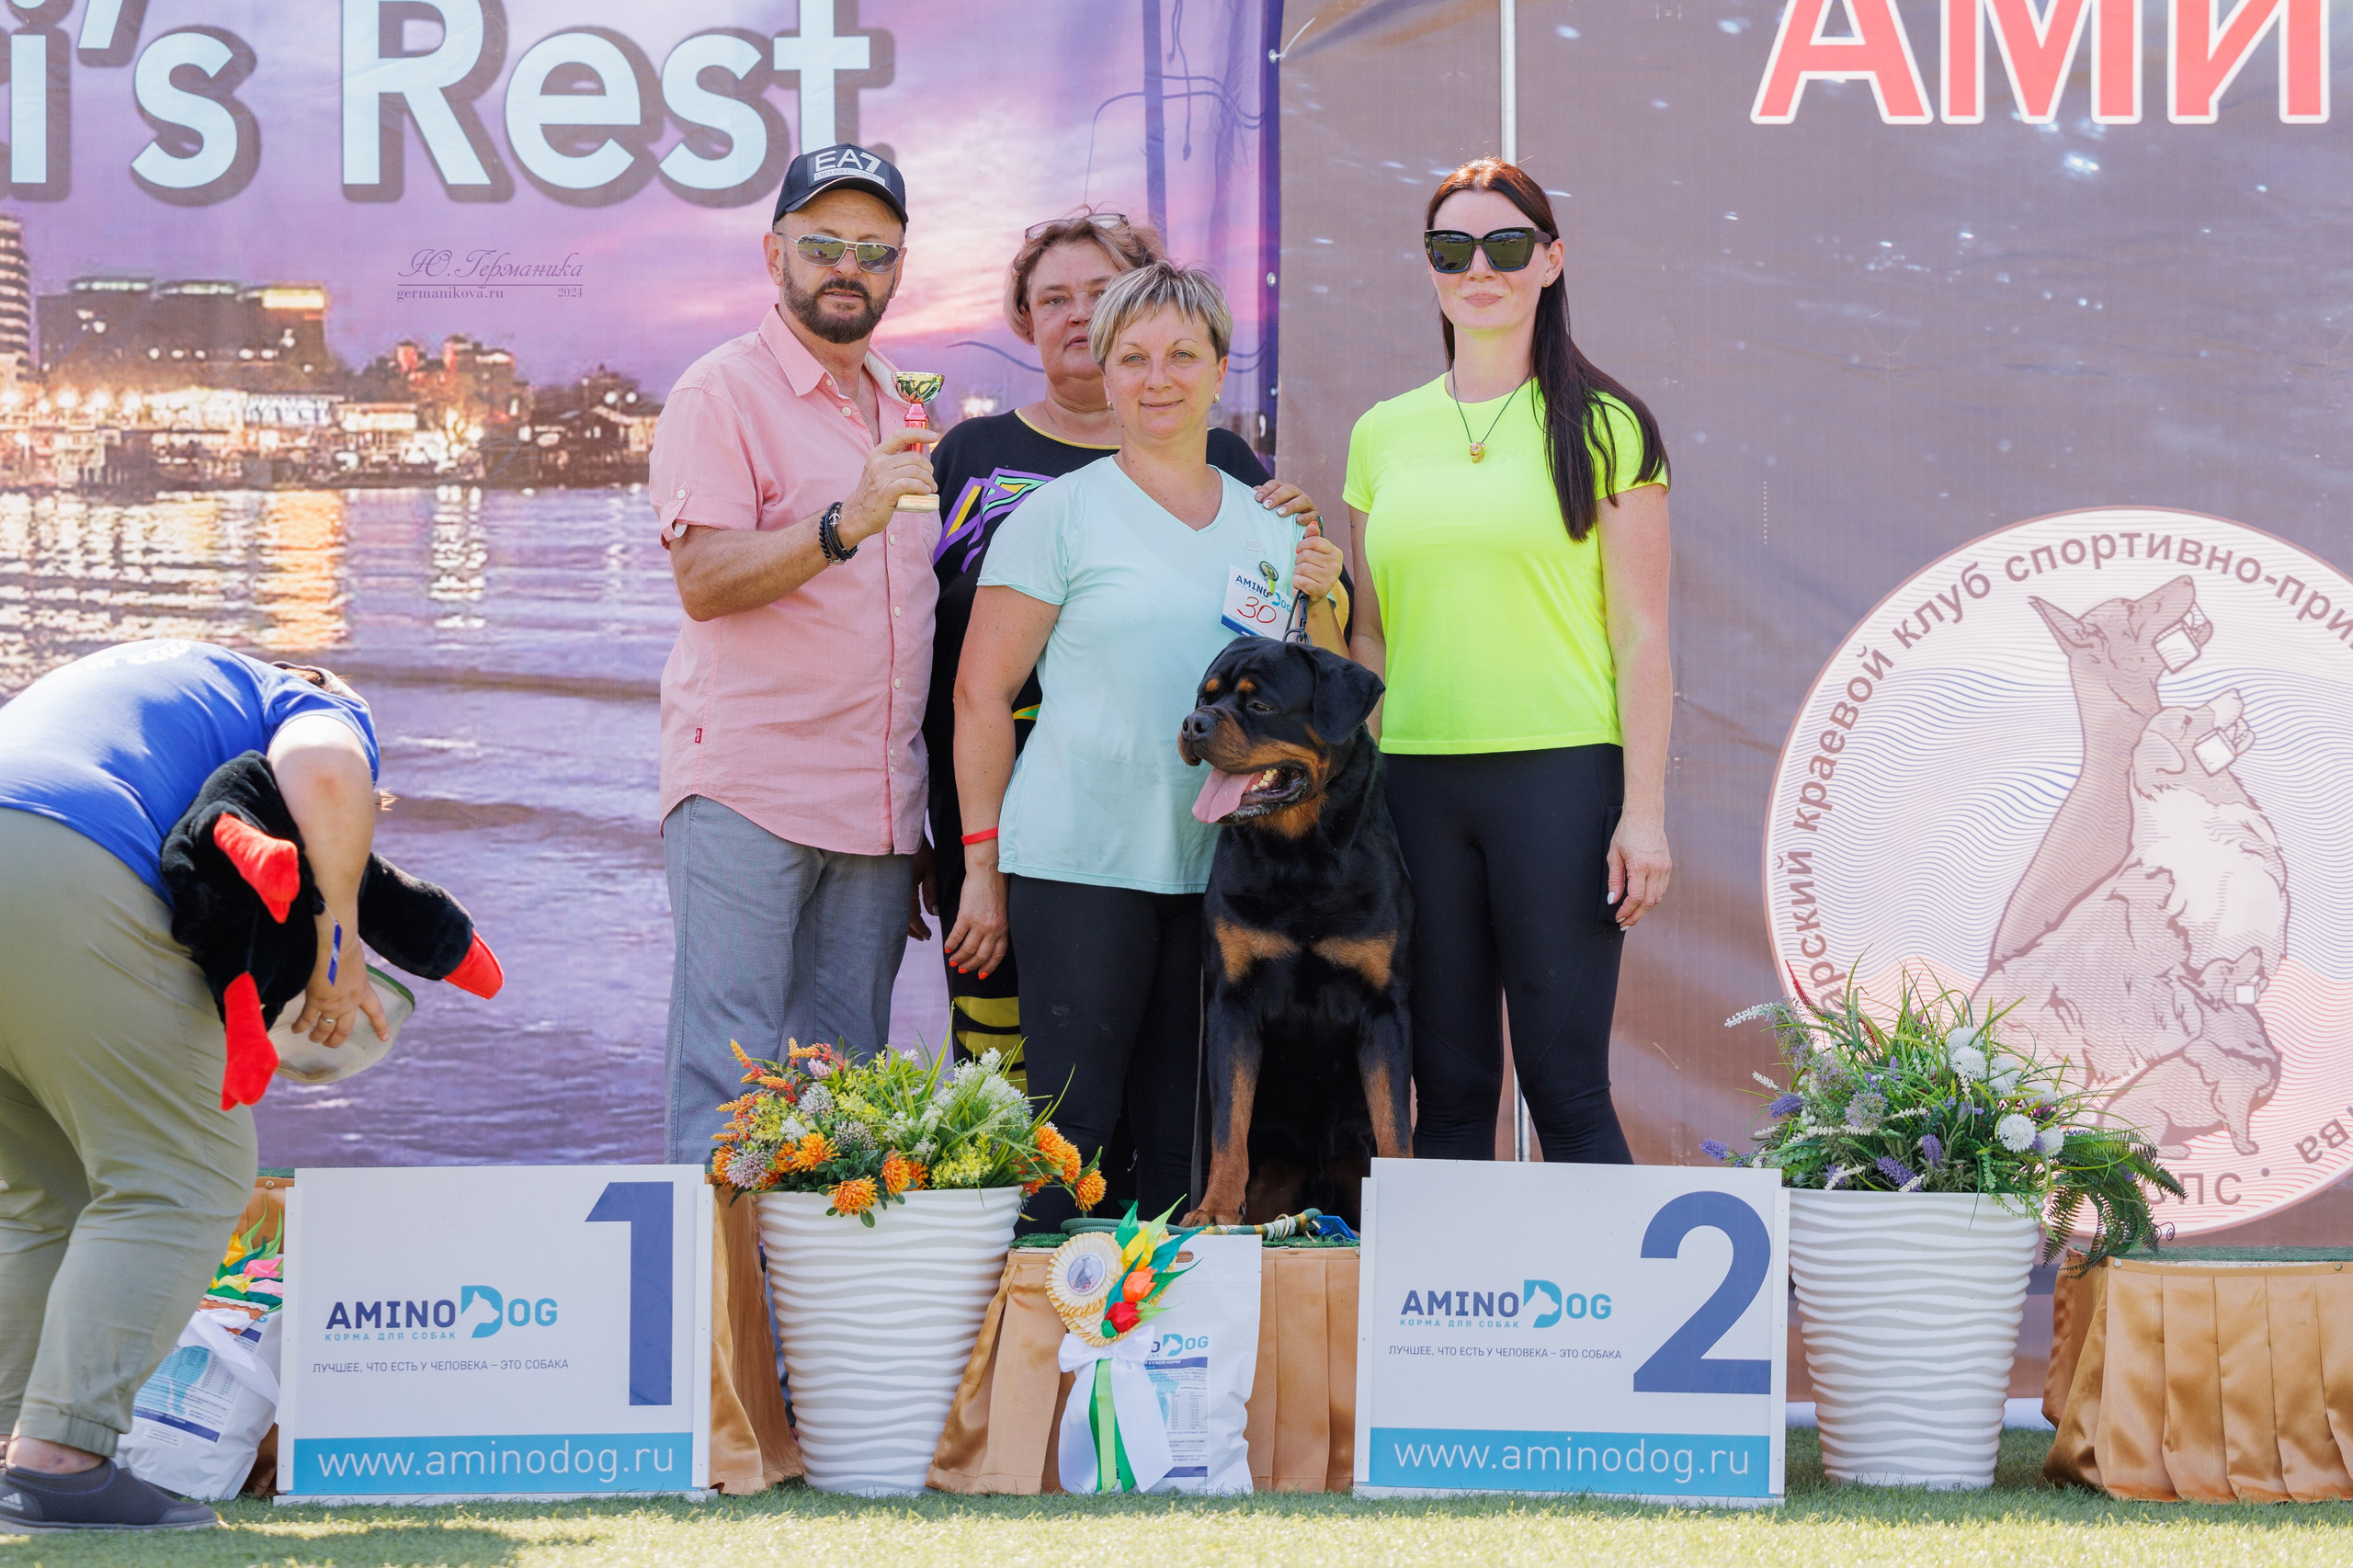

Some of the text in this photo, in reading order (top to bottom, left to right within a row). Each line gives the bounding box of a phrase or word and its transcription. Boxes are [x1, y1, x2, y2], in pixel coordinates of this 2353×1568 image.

[343, 0, 870, 189] Rest
[814, 148, 882, 174] EA7
[1236, 596, 1277, 624] 30
[1777, 531, 2353, 1012] арский краевой клуб спортивно-при
[2294, 1108, 2353, 1165] ва
[2140, 1171, 2242, 1206] СПС
[585, 1181, 674, 1406] 1
[1633, 1190, 1772, 1394] 2
[324, 1331, 457, 1342] КОРМА ДЛЯ СОБАК
[1400, 1319, 1519, 1328] КОРМА ДЛЯ СОБАК
[313, 1362, 363, 1373] ЛУЧШЕЕ,
[366, 1361, 388, 1372] ЧТО
[391, 1361, 418, 1372] ЕСТЬ
[420, 1360, 428, 1371] У
[430, 1360, 488, 1371] ЧЕЛОВЕКА
[500, 1359, 521, 1370] ЭТО
[525, 1358, 569, 1369] СОБАКА
[1389, 1346, 1435, 1357] ЛУЧШЕЕ,
[1438, 1346, 1457, 1357] ЧТО
[1460, 1346, 1483, 1357] ЕСТЬ
[1486, 1347, 1494, 1357] У
[1495, 1347, 1548, 1358] ЧЕЛОВЕКА
[1560, 1348, 1579, 1358] ЭТО
[1582, 1349, 1621, 1359] СОБАКА
[318, 1439, 673, 1483] www.aminodog.ru
[1394, 1435, 1749, 1484] www.aminodog.ru
